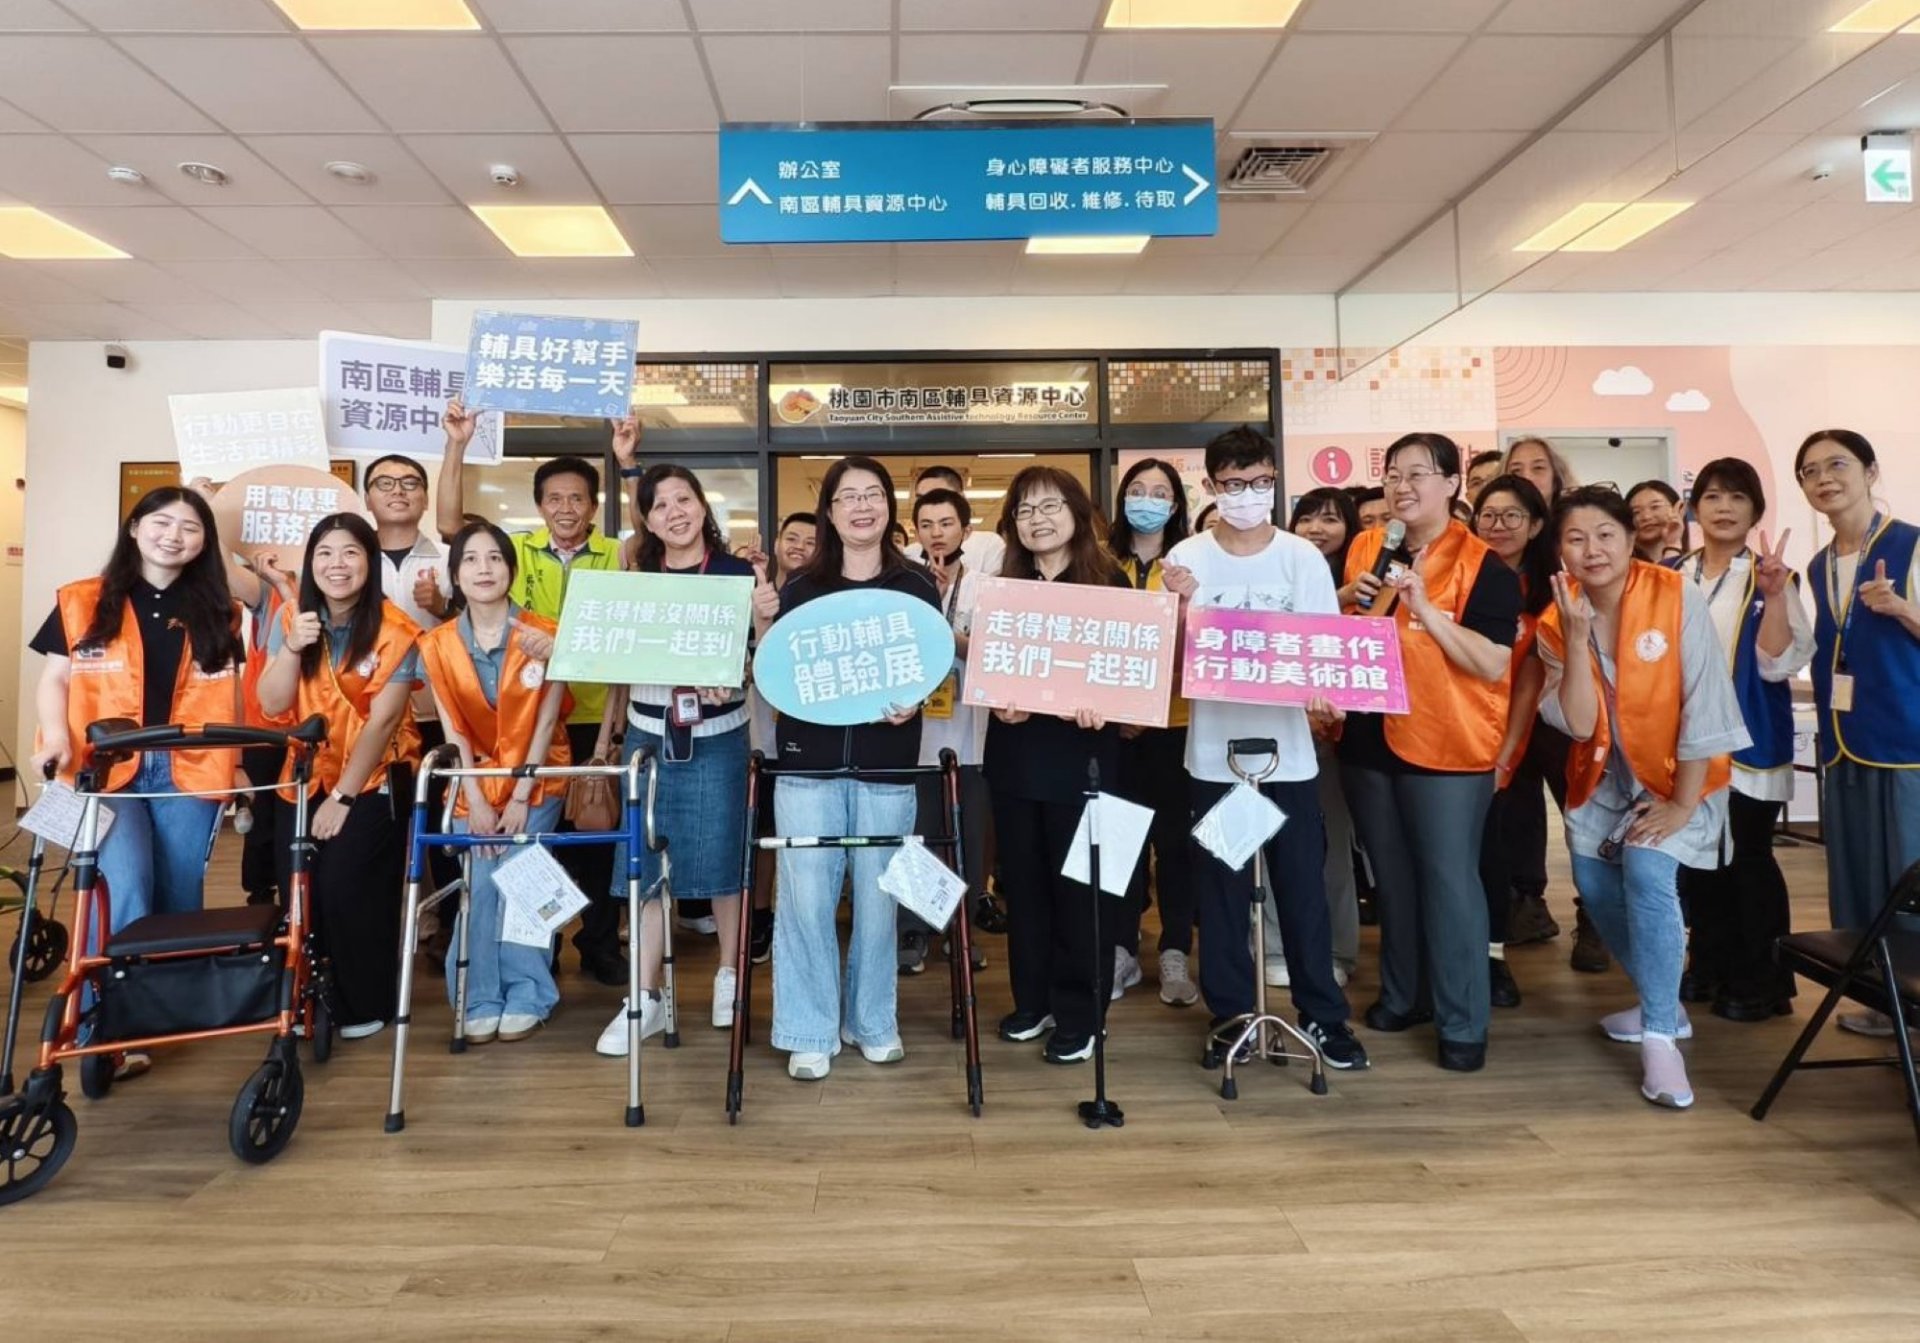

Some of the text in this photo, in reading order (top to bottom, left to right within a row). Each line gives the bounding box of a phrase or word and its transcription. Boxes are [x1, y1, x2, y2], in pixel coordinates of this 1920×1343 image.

[778, 160, 841, 180] 辦公室
[986, 156, 1174, 176] 身心障礙者服務中心
[779, 193, 948, 215] 南區輔具資源中心
[478, 332, 628, 367] 輔具好幫手
[475, 361, 626, 396] 樂活每一天
[829, 386, 1086, 410] 桃園市南區輔具資源中心
[829, 414, 866, 424] Taoyuan
[867, 413, 883, 424] City
[886, 413, 925, 422] Southern
[927, 413, 964, 421] Assistive
[1059, 411, 1088, 420] Center
[244, 484, 339, 512] 用電優惠
[577, 599, 737, 626] 走得慢沒關係
[571, 625, 734, 658] 我們一起到
[788, 611, 916, 661] 行動輔具
[986, 608, 1161, 652] 走得慢沒關係
[1194, 627, 1386, 661] 身障者畫作
[794, 642, 925, 705] 體驗展
[983, 640, 1158, 690] 我們一起到
[1193, 655, 1389, 691] 行動美術館
